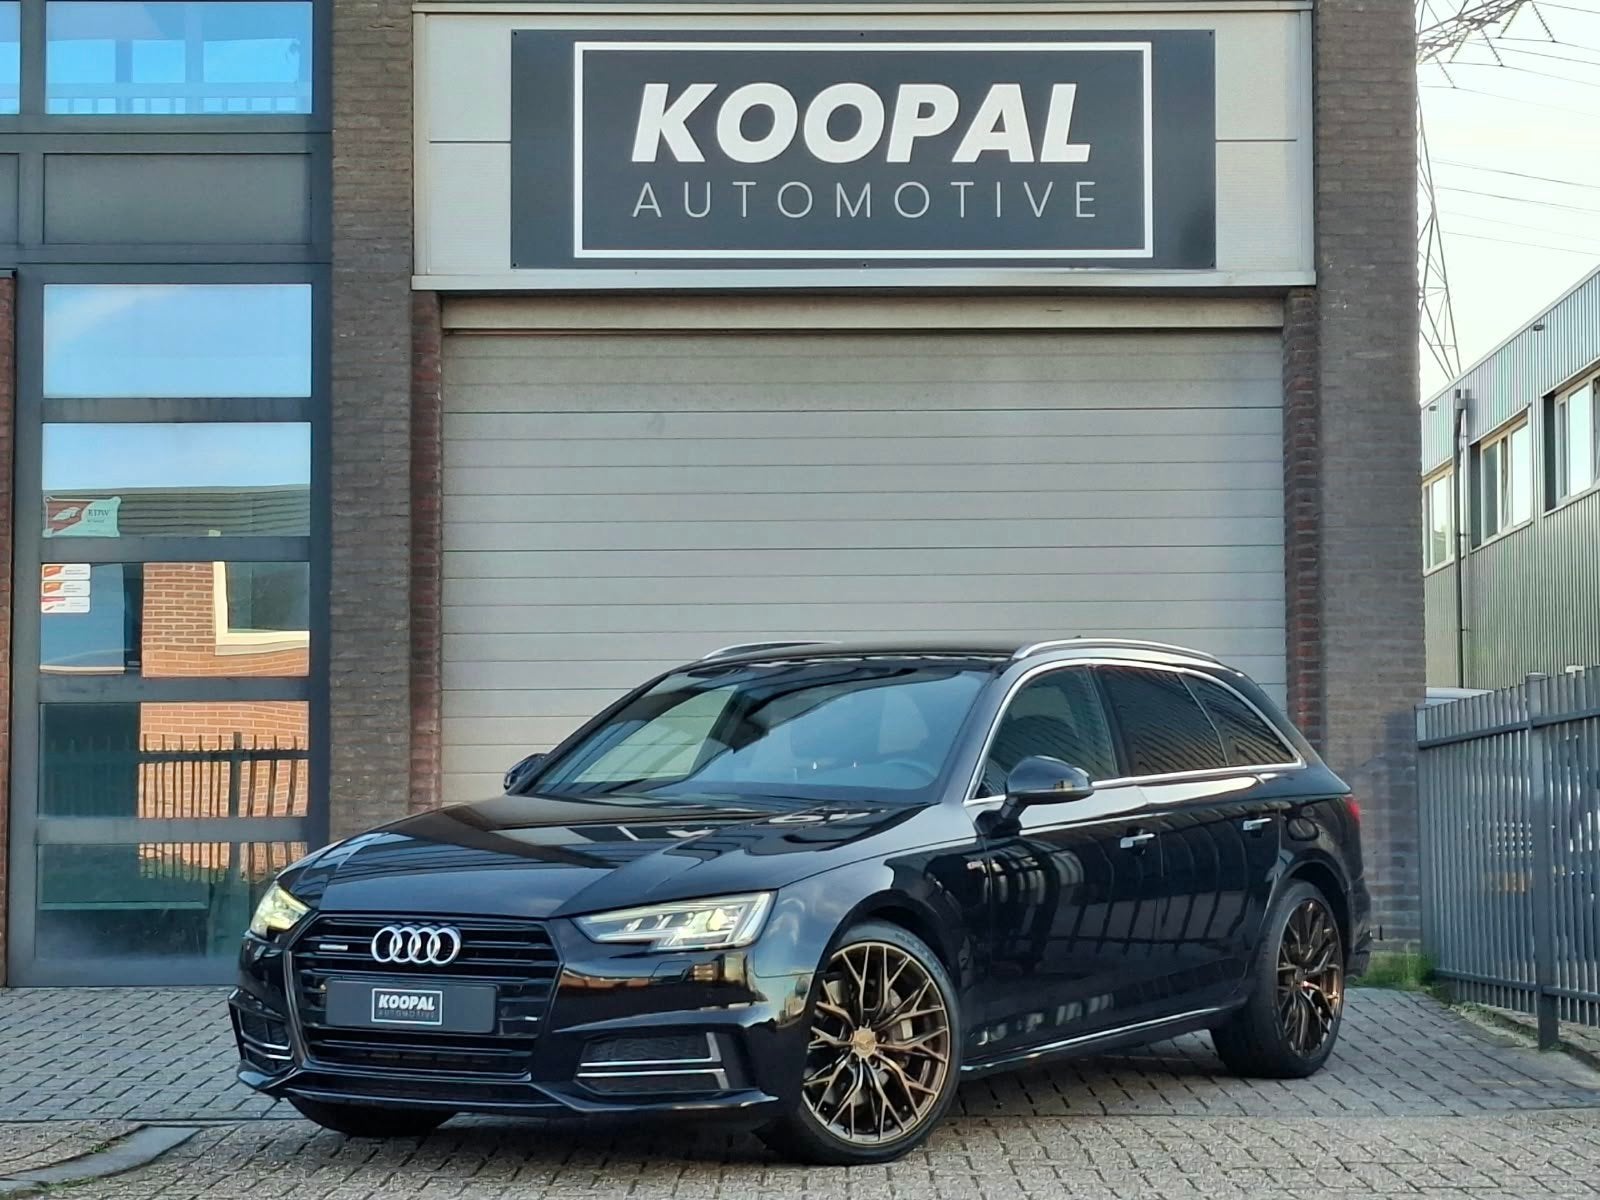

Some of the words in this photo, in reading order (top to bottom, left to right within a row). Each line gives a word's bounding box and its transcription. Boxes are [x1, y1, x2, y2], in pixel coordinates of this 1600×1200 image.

[631, 82, 1091, 163] KOOPAL
[632, 181, 1097, 218] AUTOMOTIVE
[378, 994, 435, 1011] KOOPAL
